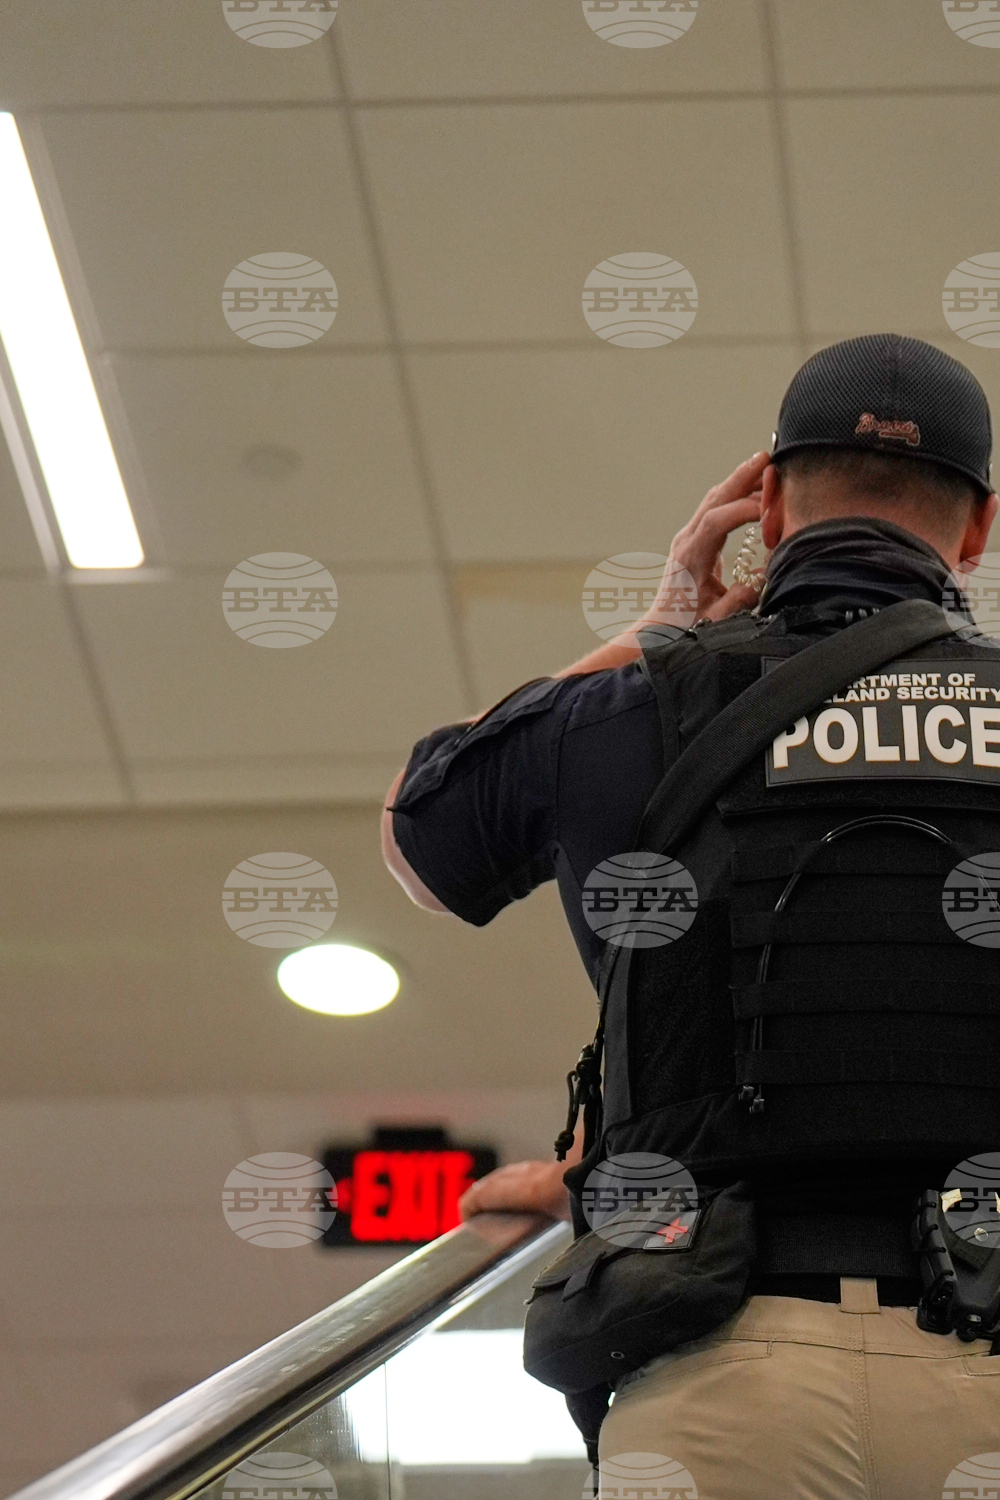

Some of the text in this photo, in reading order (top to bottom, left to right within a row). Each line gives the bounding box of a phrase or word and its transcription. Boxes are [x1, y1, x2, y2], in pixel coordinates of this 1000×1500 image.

[848, 673, 975, 689] RTMENT OF
[824, 687, 890, 702] LAND
[351, 1151, 474, 1241] EXIT
